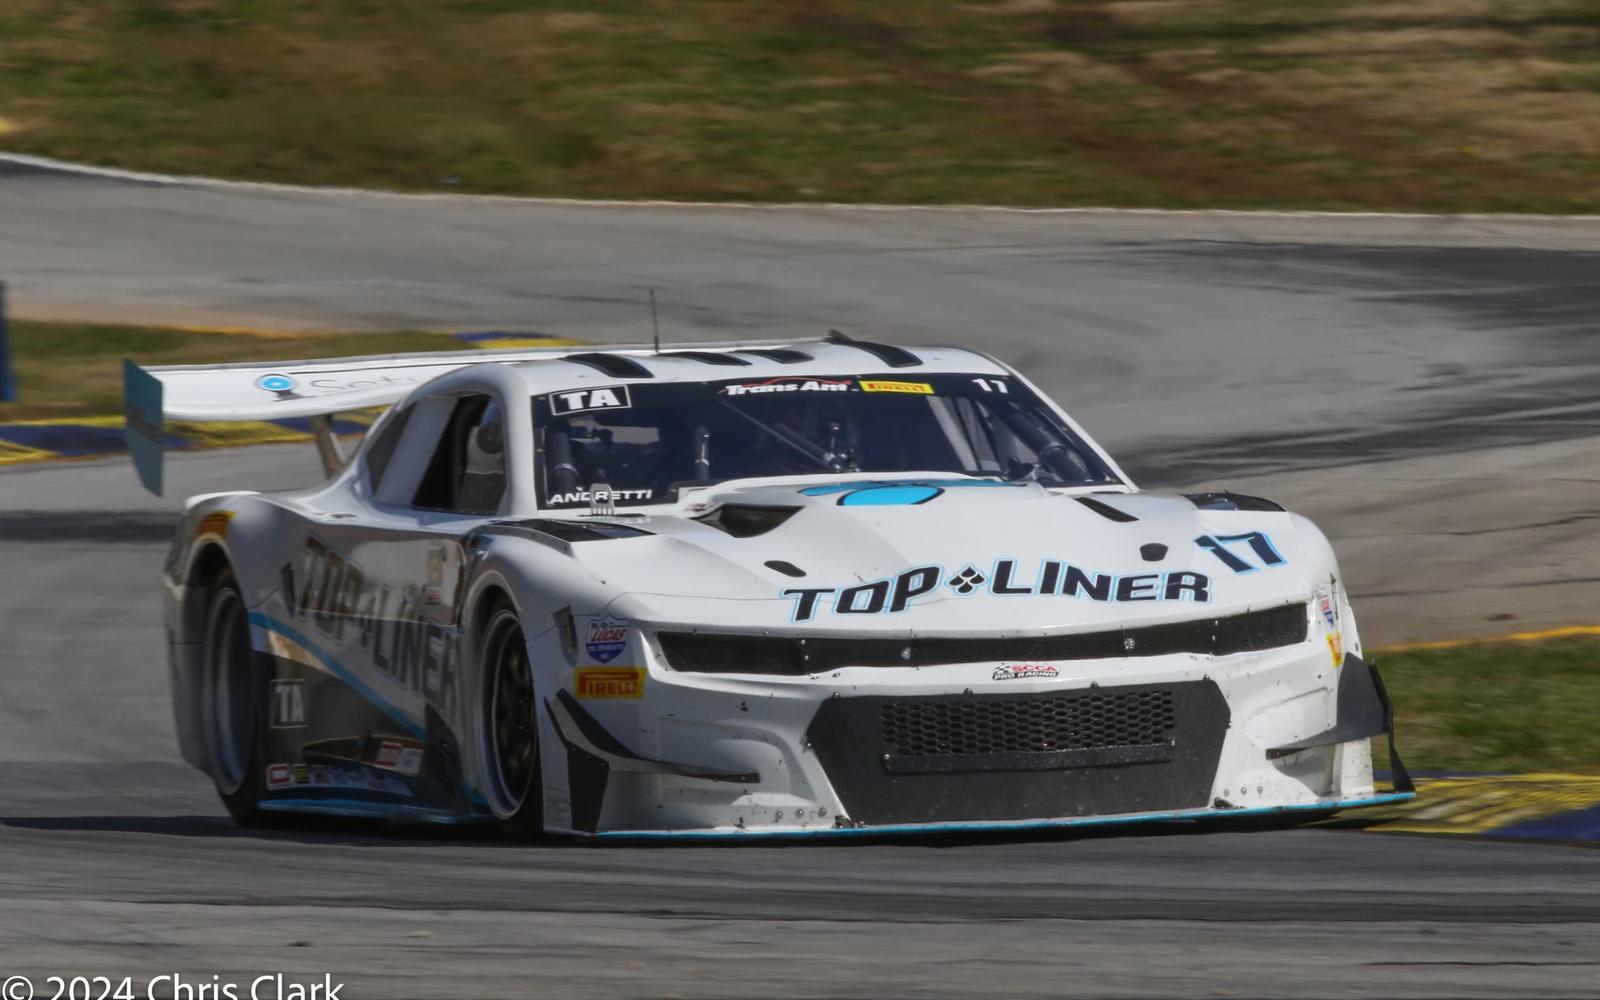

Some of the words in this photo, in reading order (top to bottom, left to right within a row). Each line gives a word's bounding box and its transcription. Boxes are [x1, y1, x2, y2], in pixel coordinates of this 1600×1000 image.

[726, 384, 798, 395] Trans
[800, 381, 847, 391] Am
[972, 378, 1008, 393] 17
[560, 388, 621, 410] TA
[550, 489, 652, 504] ANDRETTI
[1194, 530, 1287, 574] 17
[781, 563, 943, 623] TOP
[988, 557, 1213, 604] LINER
[591, 629, 627, 642] LUCAS
[578, 671, 639, 695] PIRELLI
[276, 685, 304, 722] TA
